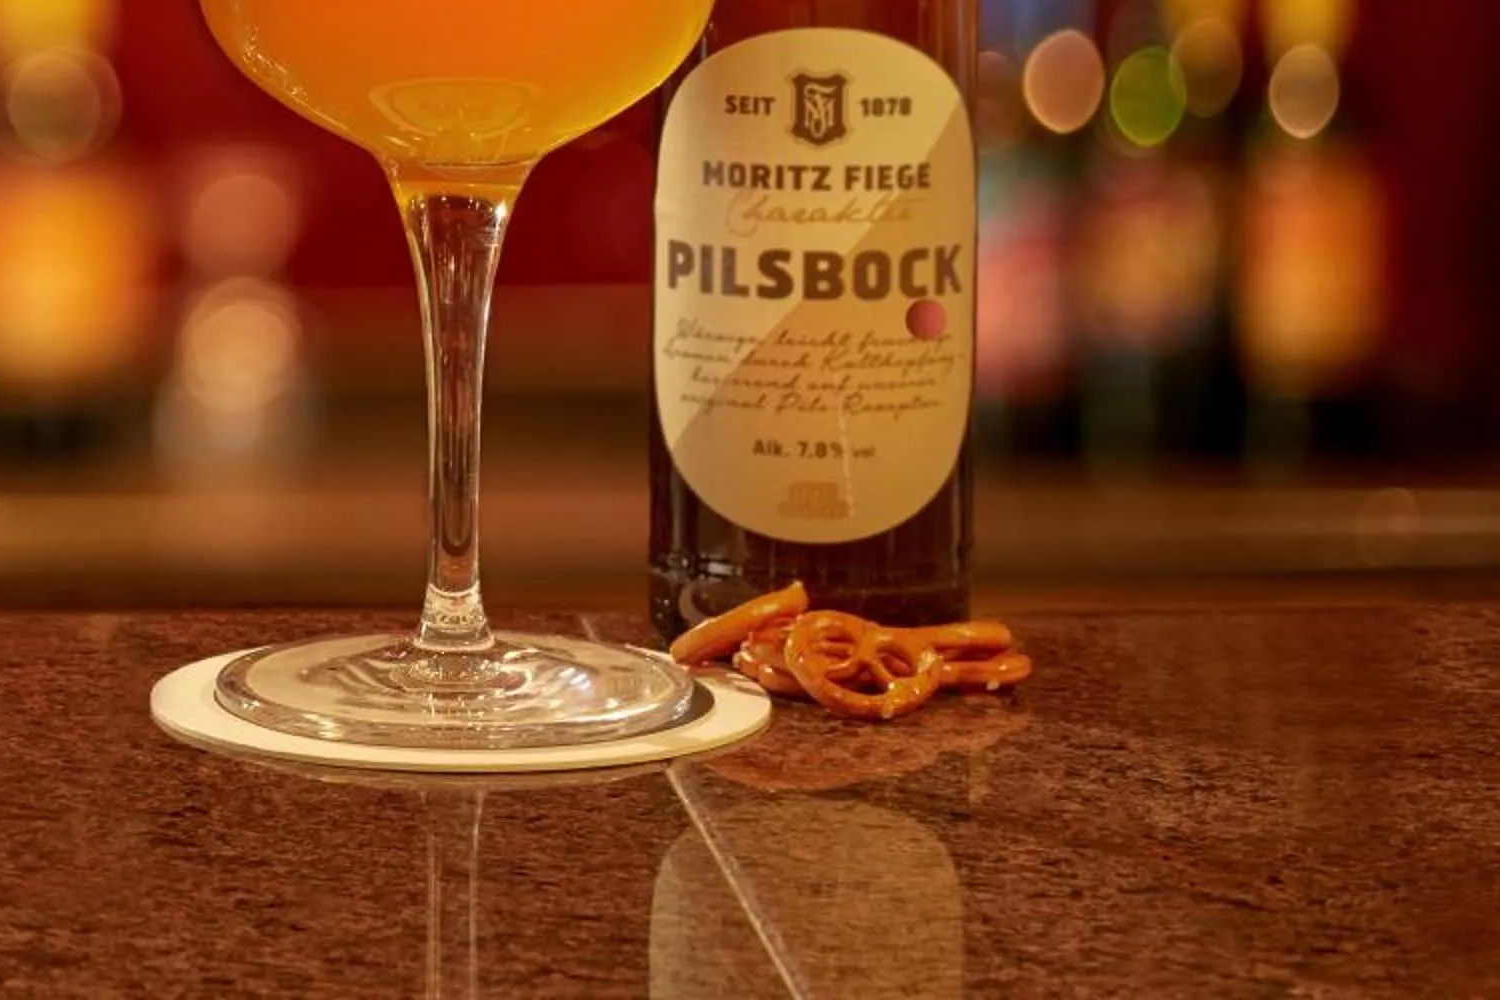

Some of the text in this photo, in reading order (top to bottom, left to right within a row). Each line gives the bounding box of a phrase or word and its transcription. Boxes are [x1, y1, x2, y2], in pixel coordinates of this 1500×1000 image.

[724, 94, 912, 117] SEIT 1878
[702, 160, 931, 191] MORITZ FIEGE
[667, 239, 962, 301] PILSBOCK
